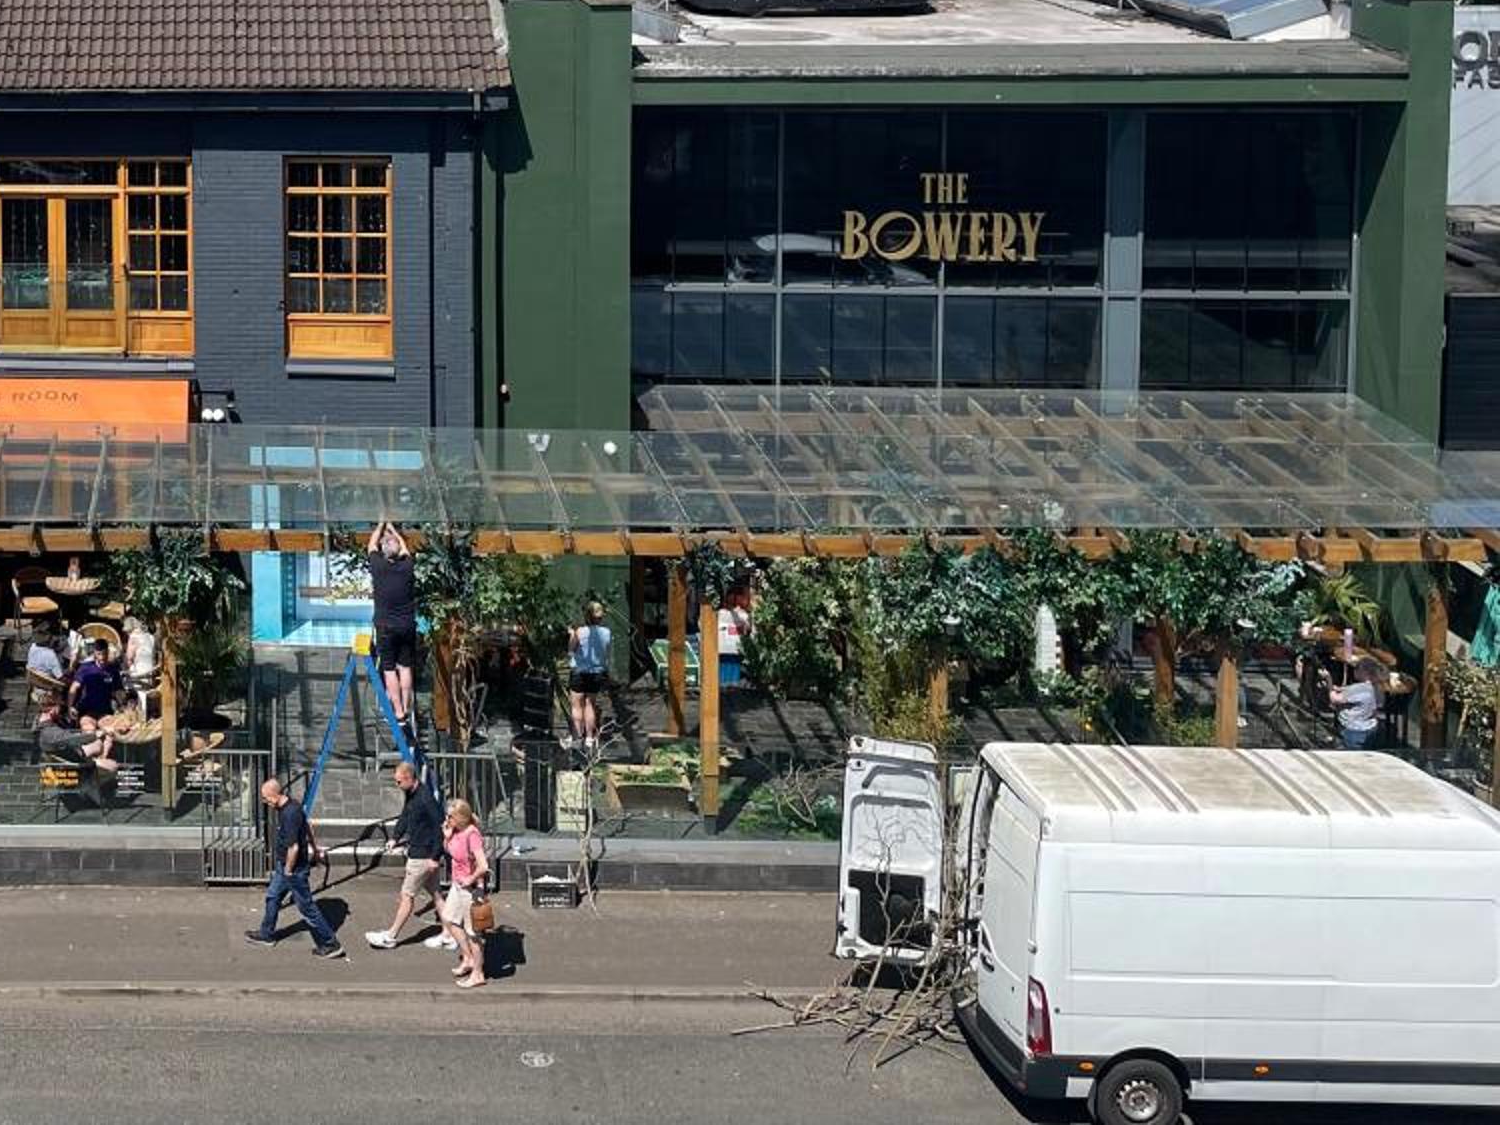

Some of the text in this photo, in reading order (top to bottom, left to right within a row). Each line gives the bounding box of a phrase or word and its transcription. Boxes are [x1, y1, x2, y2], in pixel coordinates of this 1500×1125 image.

[919, 172, 969, 204] THE
[840, 211, 1045, 262] BOWERY
[12, 390, 79, 402] ROOM
